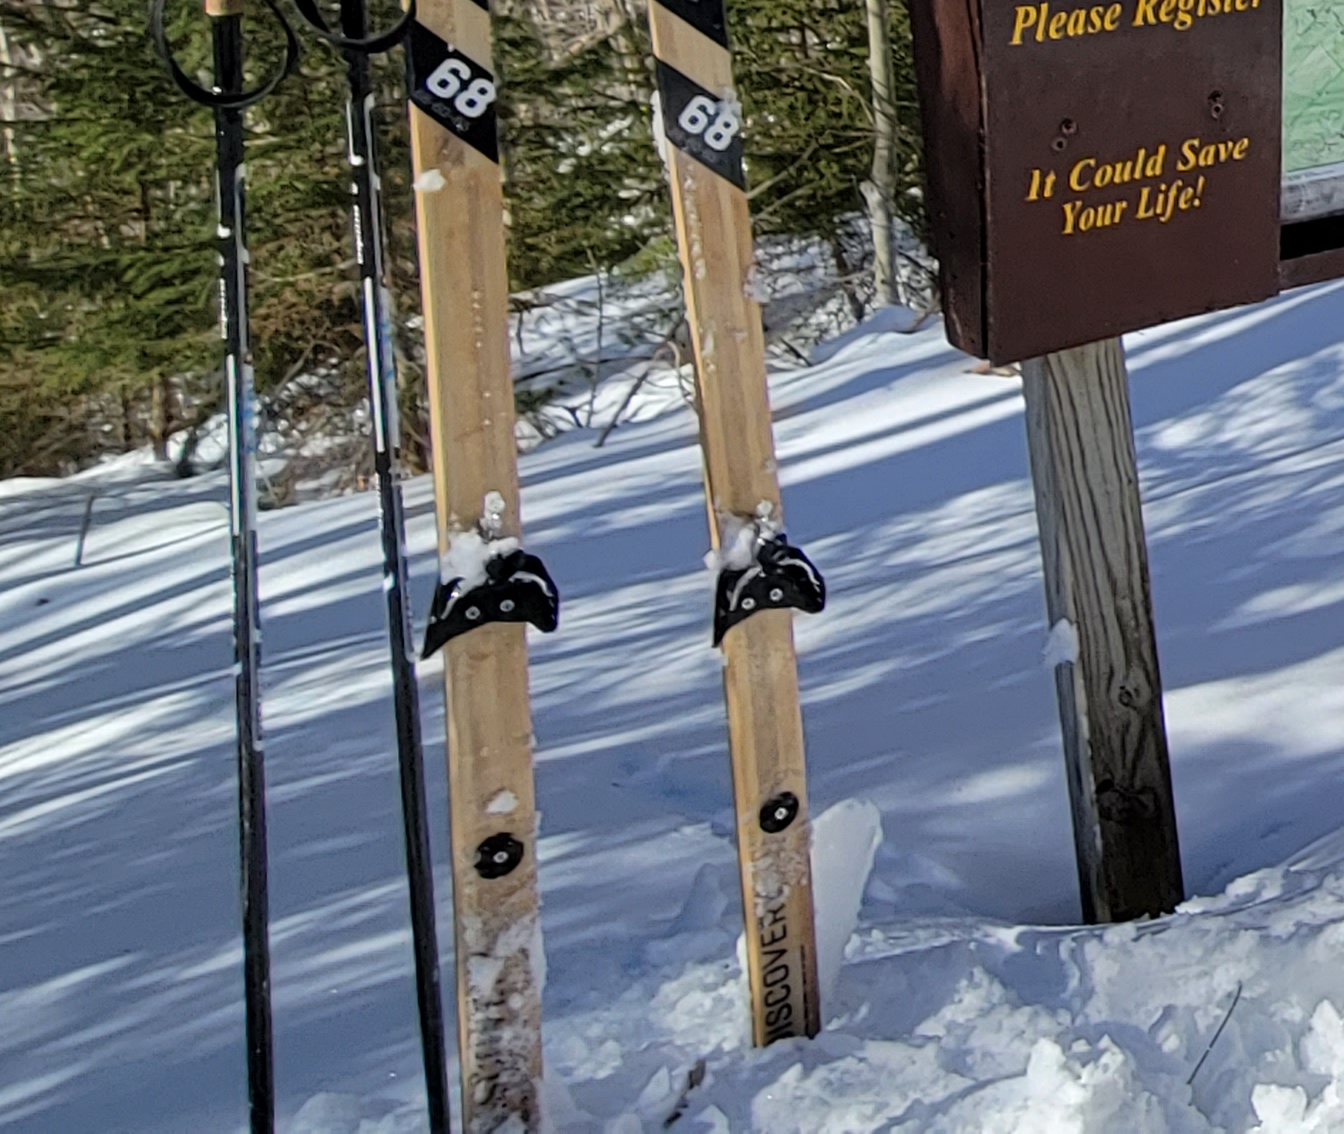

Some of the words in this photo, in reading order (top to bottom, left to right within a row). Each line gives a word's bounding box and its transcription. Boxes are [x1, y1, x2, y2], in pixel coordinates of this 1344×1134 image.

[1008, 2, 1122, 45] Please
[425, 58, 497, 118] 68
[678, 94, 740, 151] 68
[1025, 168, 1056, 201] It
[1068, 144, 1166, 192] Could
[1177, 137, 1249, 171] Save
[1061, 200, 1128, 235] Your
[1136, 175, 1206, 223] Life!
